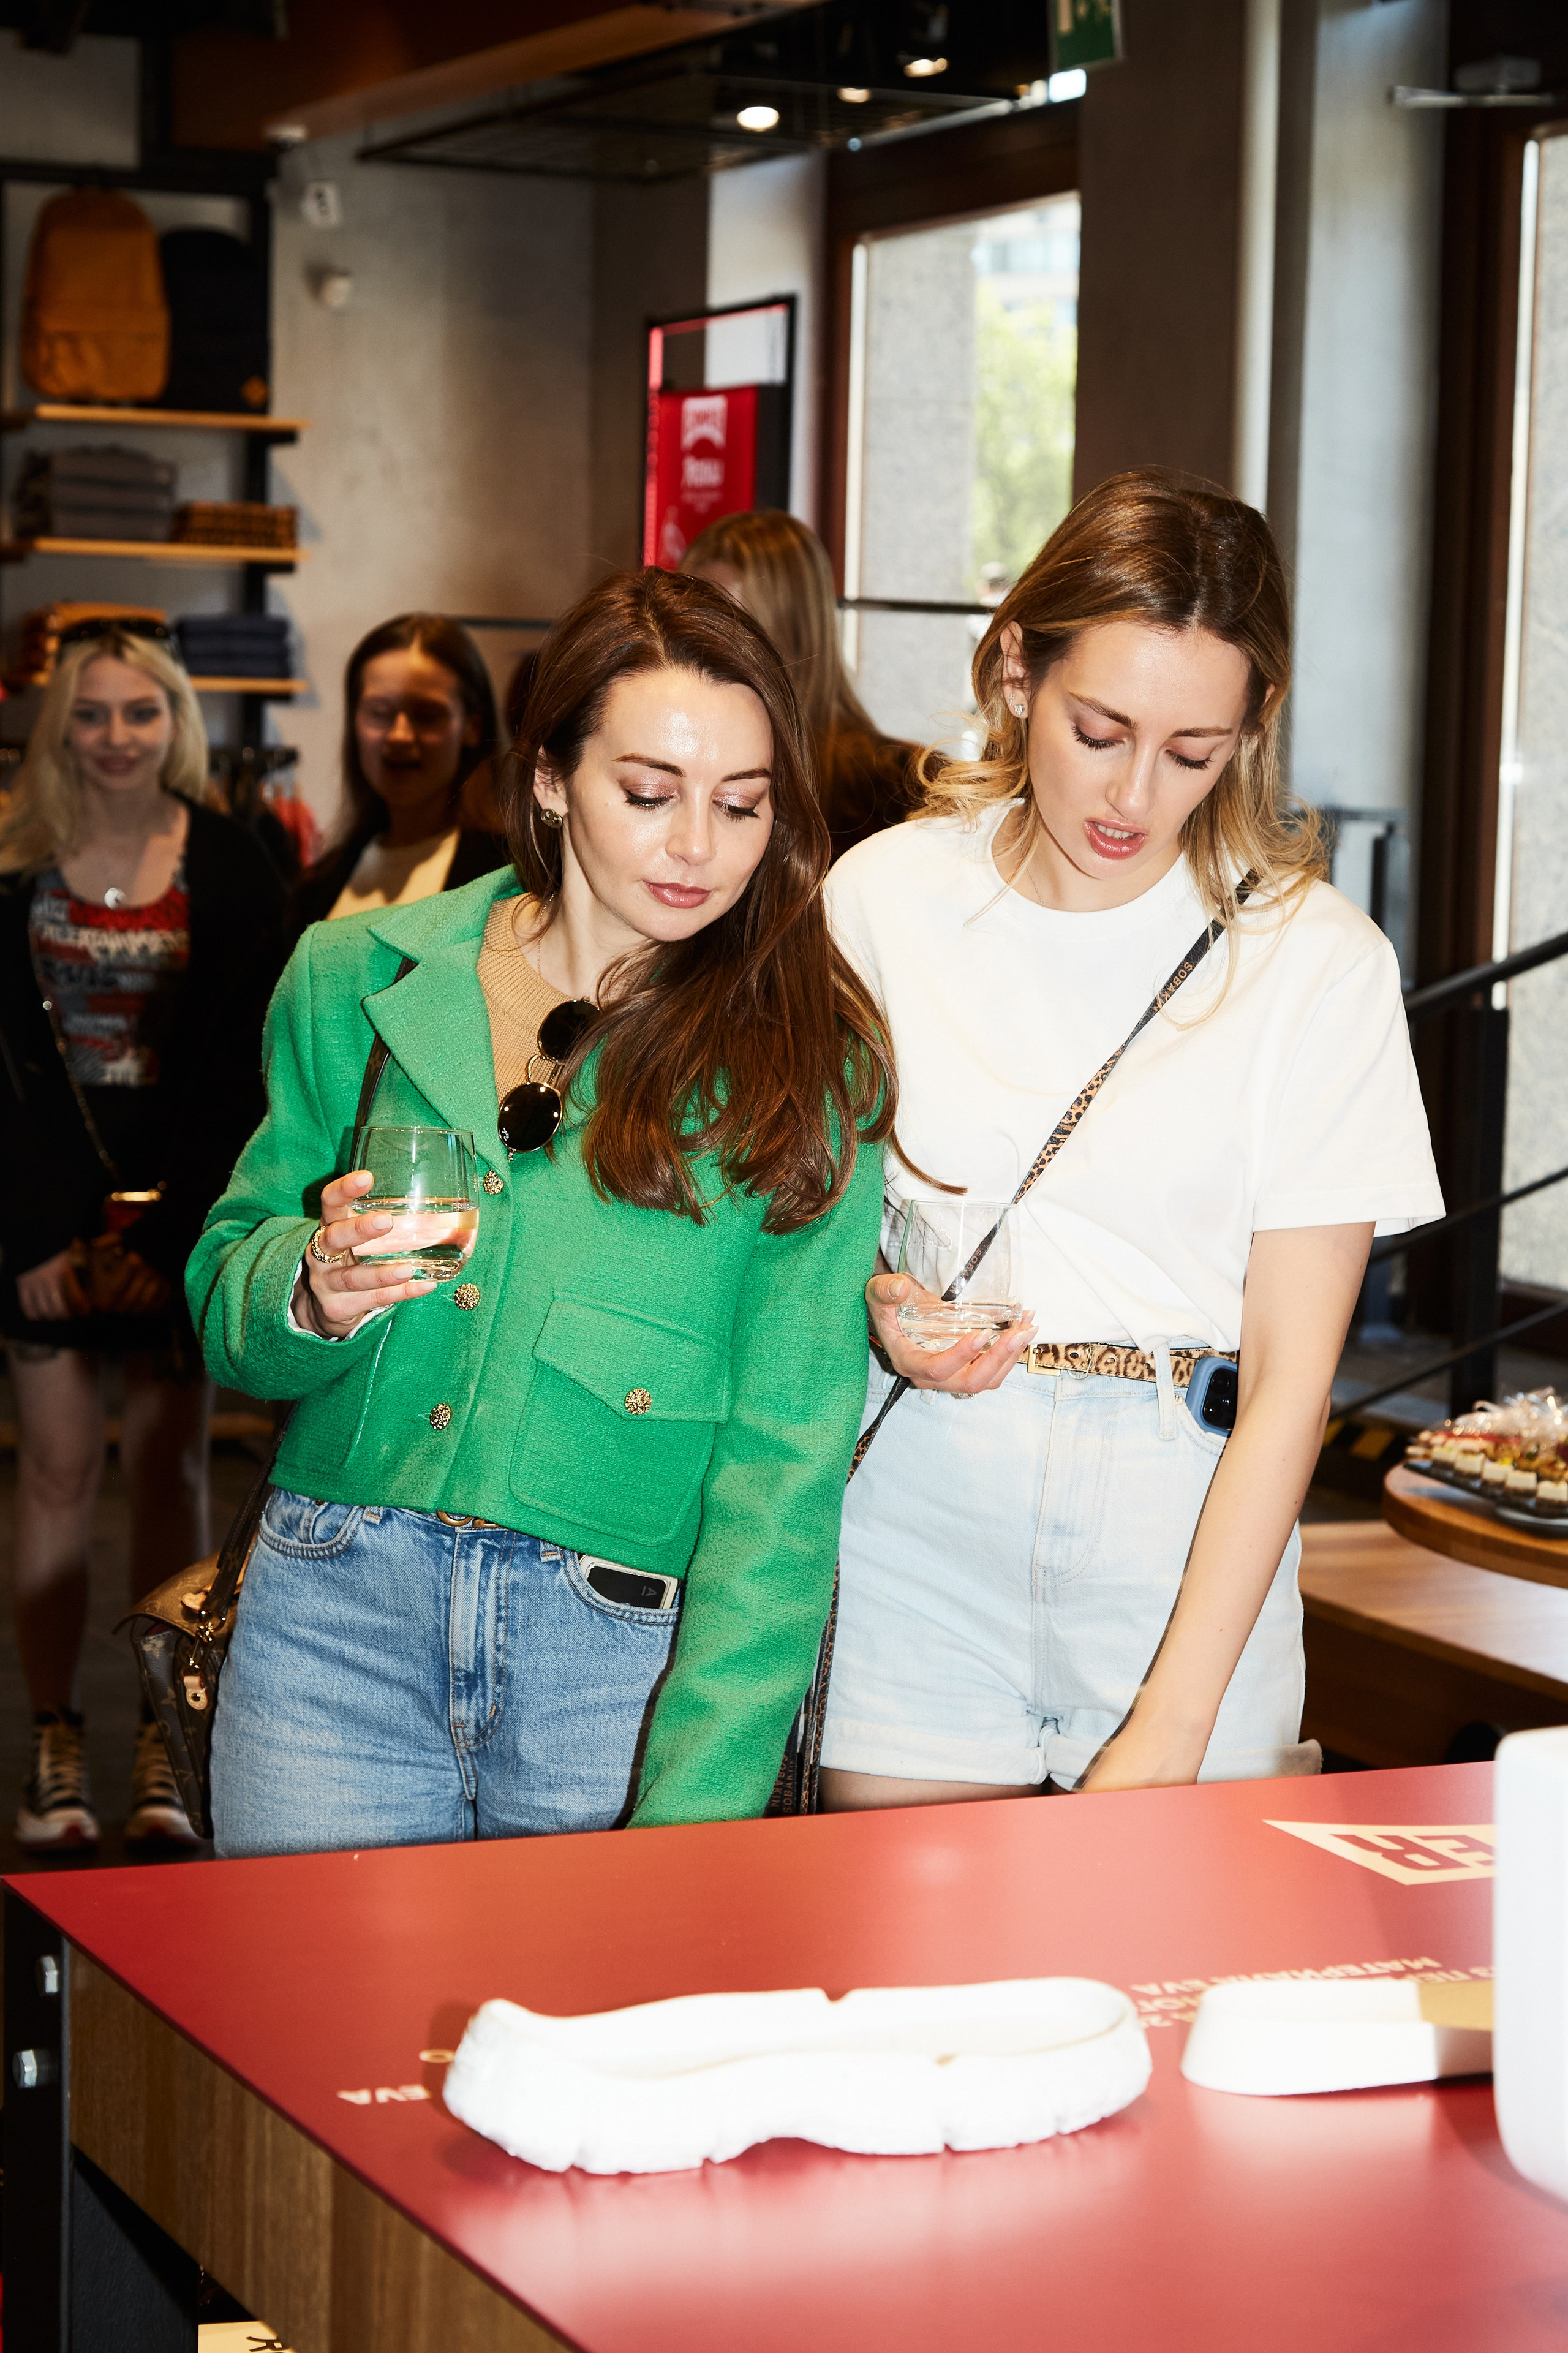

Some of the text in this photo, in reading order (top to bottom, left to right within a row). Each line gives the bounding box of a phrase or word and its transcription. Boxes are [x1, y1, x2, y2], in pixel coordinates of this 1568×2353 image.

[949, 1248, 982, 1294] SOBAN
[783, 1761, 794, 1813] SOBAK
[1328, 1834, 1496, 1871] ER
[1130, 1978, 1205, 1995] EVA
[337, 2085, 431, 2105] EVA
